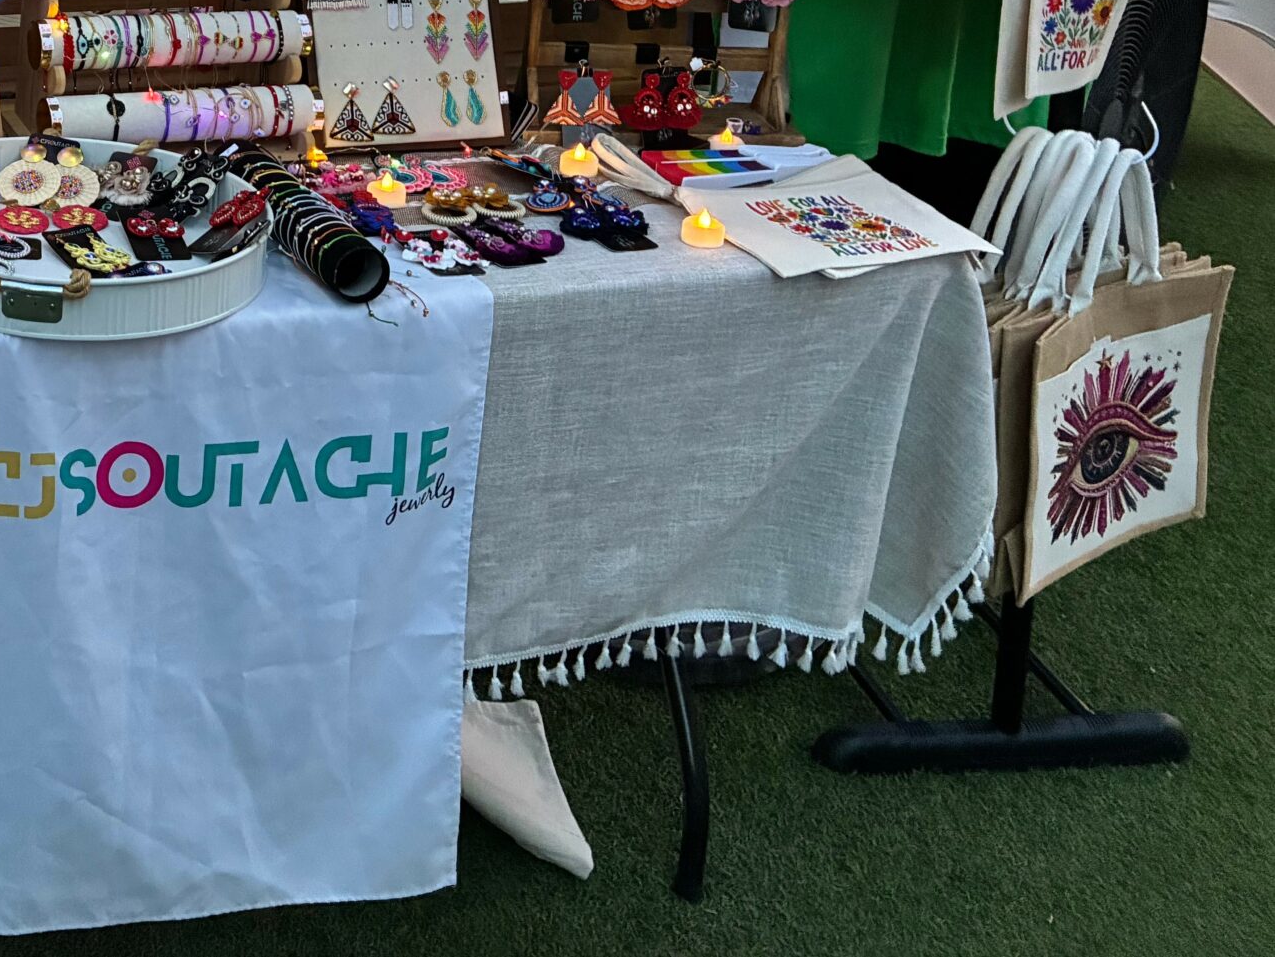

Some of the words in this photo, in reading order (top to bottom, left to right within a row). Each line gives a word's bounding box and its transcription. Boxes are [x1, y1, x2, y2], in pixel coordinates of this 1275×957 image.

[1061, 50, 1087, 71] FOR
[745, 198, 787, 217] LOVE
[788, 196, 820, 210] FOR
[824, 194, 857, 208] ALL
